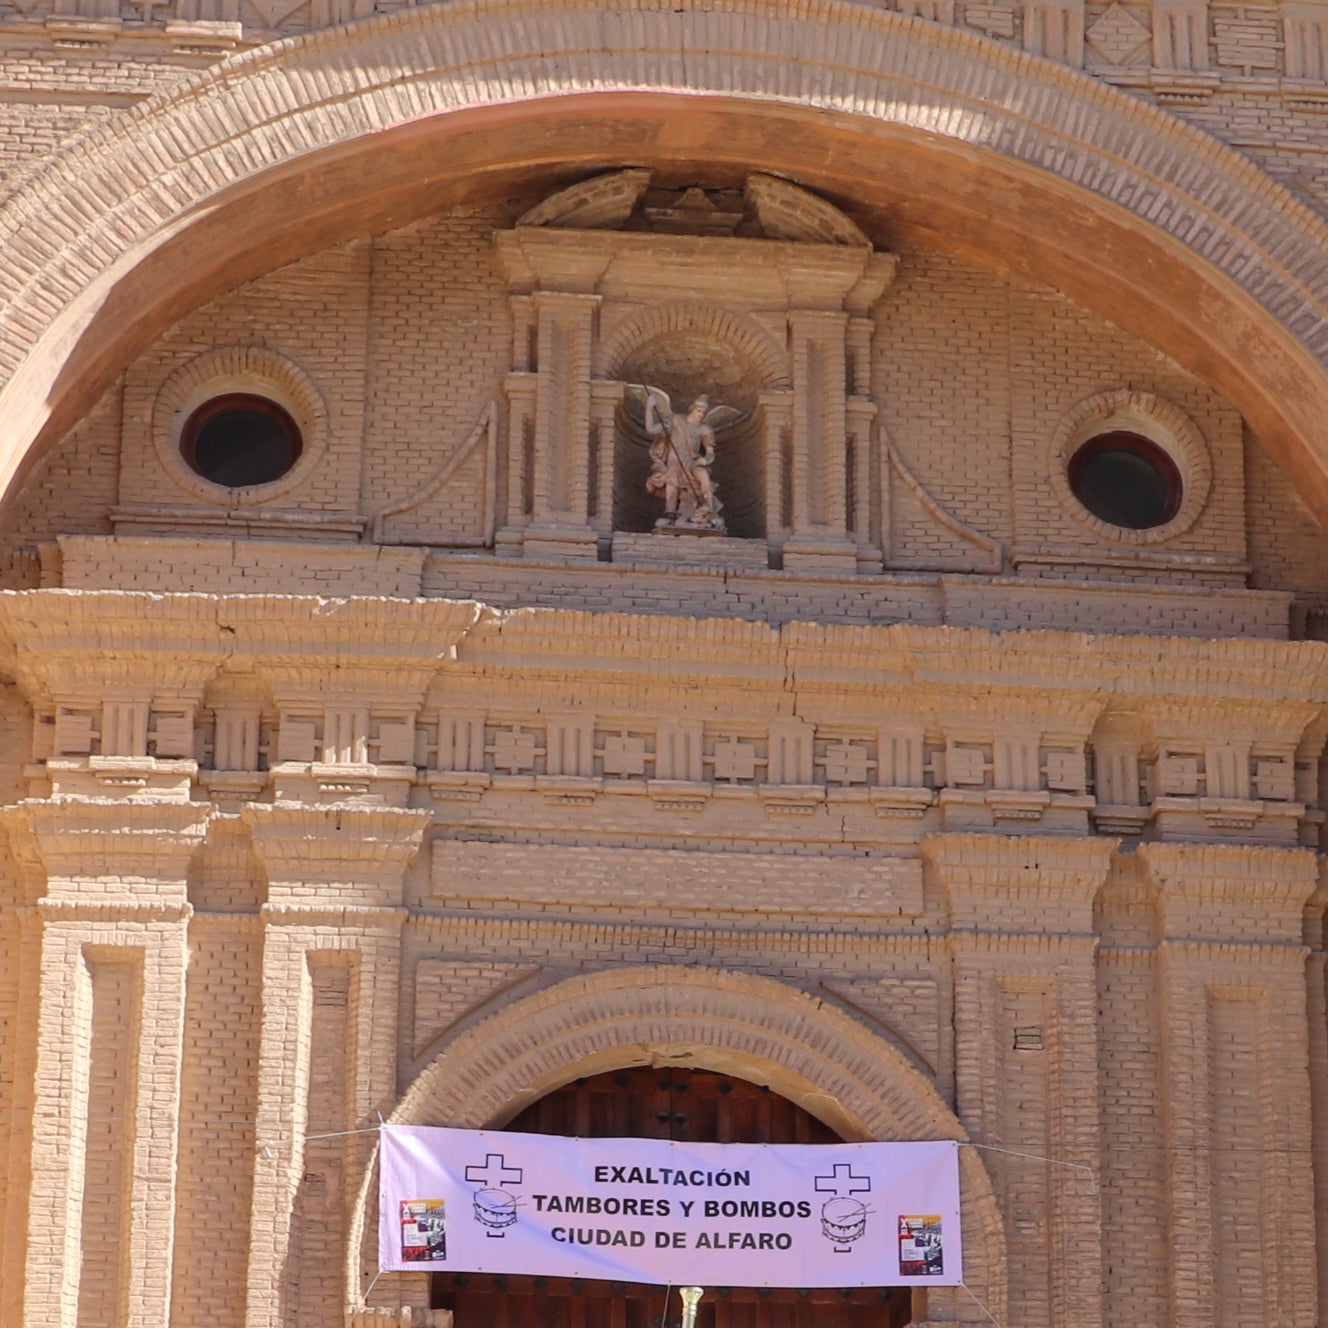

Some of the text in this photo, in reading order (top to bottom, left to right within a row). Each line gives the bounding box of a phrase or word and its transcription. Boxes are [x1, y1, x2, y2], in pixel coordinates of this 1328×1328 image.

[594, 1165, 751, 1187] EXALTACIÓN
[532, 1194, 812, 1218] TAMBORES Y BOMBOS
[551, 1226, 793, 1250] CIUDAD DE ALFARO
